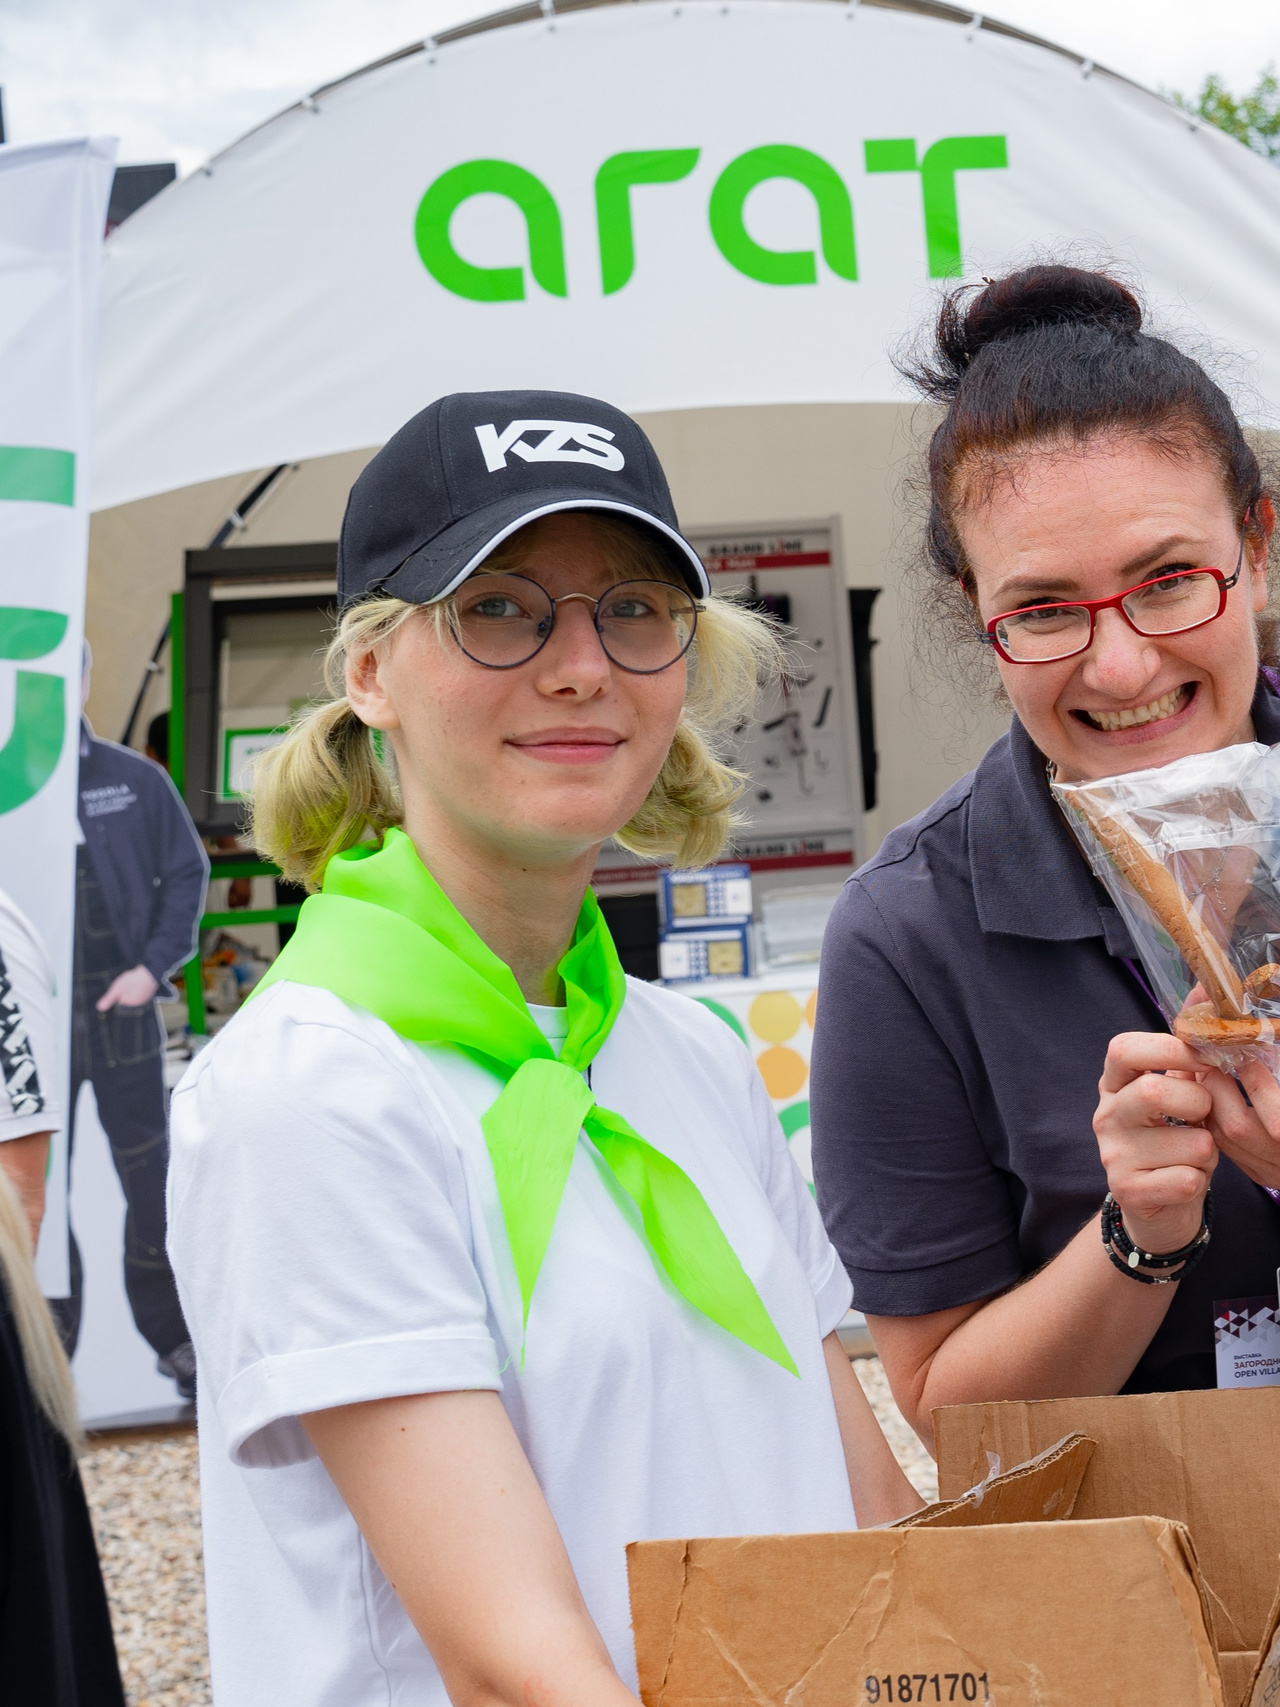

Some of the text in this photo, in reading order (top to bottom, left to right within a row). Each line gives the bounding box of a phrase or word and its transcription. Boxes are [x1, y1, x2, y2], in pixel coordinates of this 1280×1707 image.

[474, 419, 625, 473] KZS
[1234, 1352, 1262, 1360] ВЫСТАВКА
[1234, 1369, 1258, 1379] OPEN
[865, 1672, 990, 1704] 91871701
